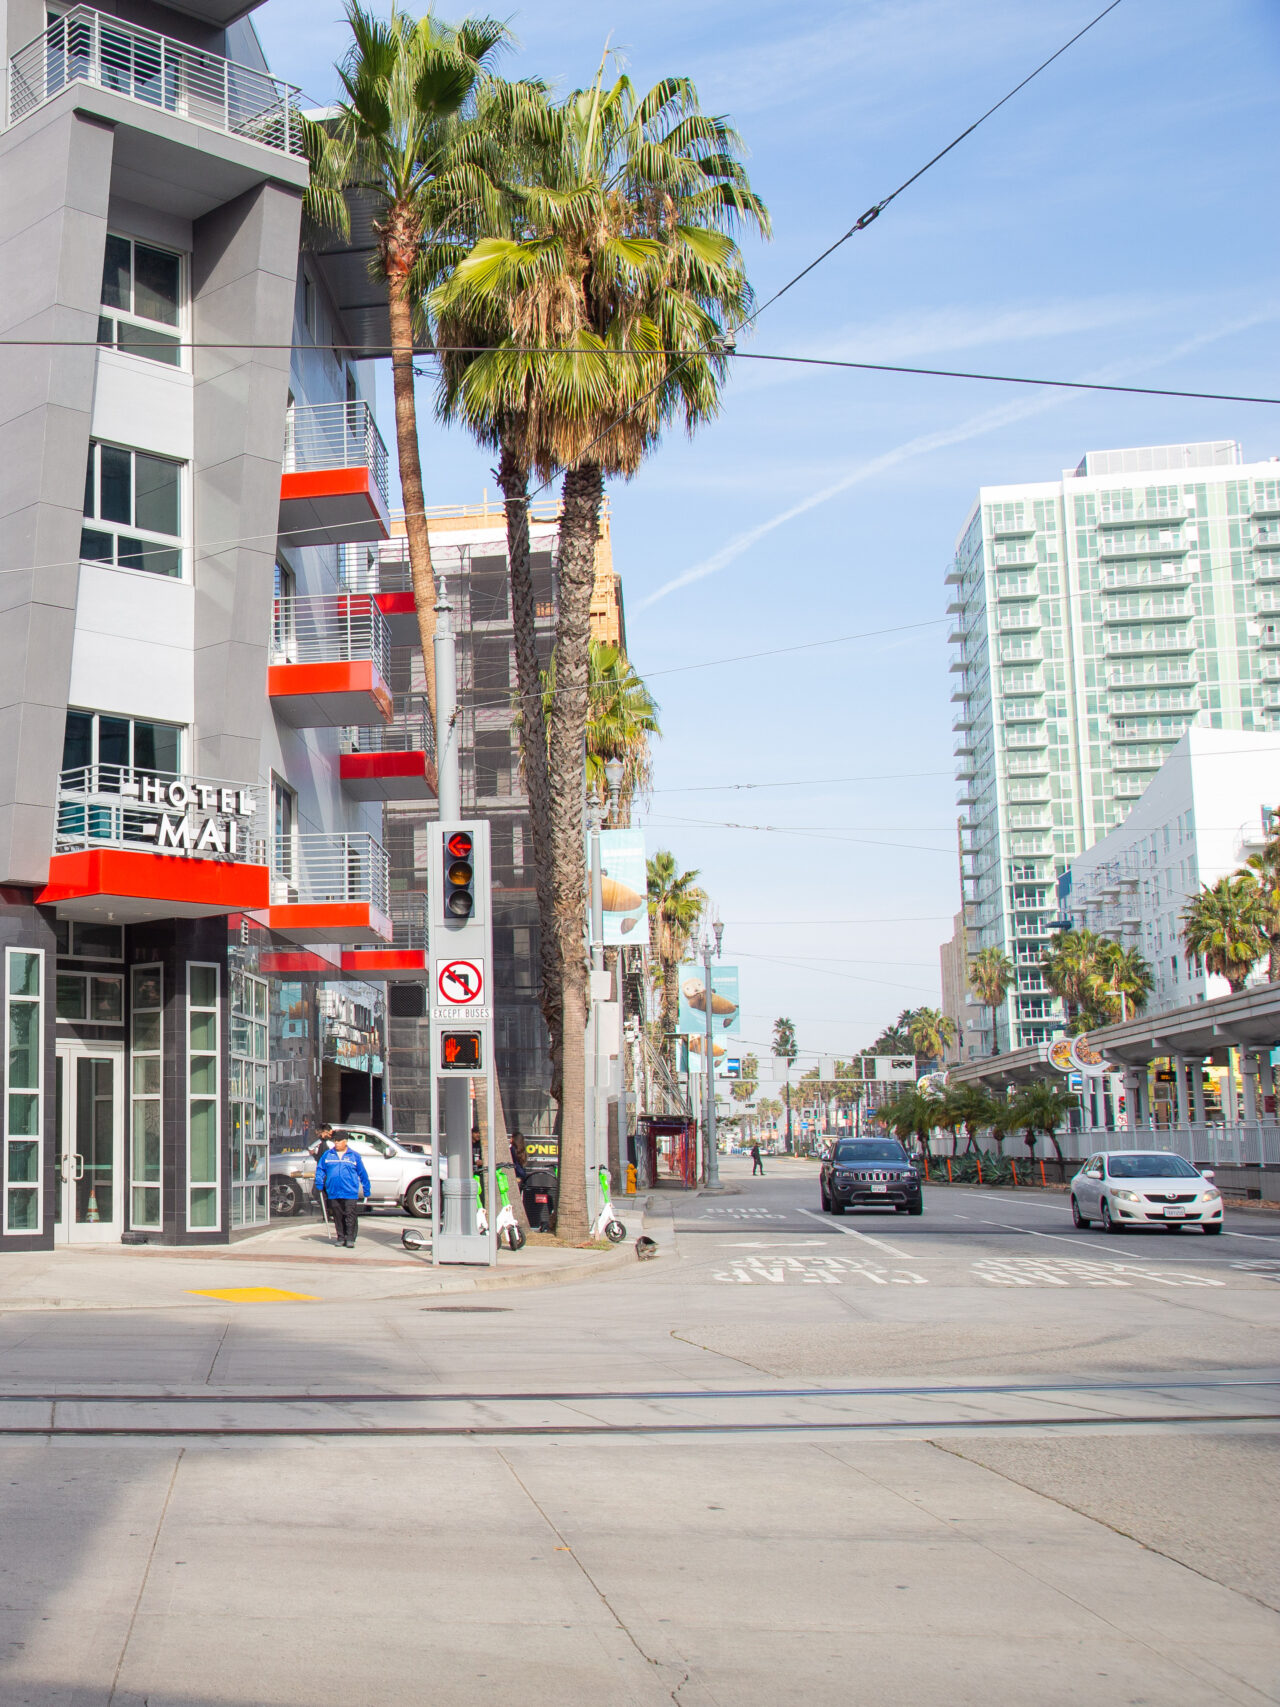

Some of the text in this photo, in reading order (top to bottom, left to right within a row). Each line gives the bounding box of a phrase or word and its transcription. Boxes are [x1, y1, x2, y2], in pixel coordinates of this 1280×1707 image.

[141, 776, 254, 816] HOTEL
[156, 813, 237, 853] MAI
[433, 1008, 490, 1019] EXCEPT BUSES
[728, 1257, 885, 1269] KEEP
[971, 1259, 1148, 1271] KEEP
[708, 1267, 929, 1284] CLEAR
[969, 1270, 1227, 1287] CLEAR
